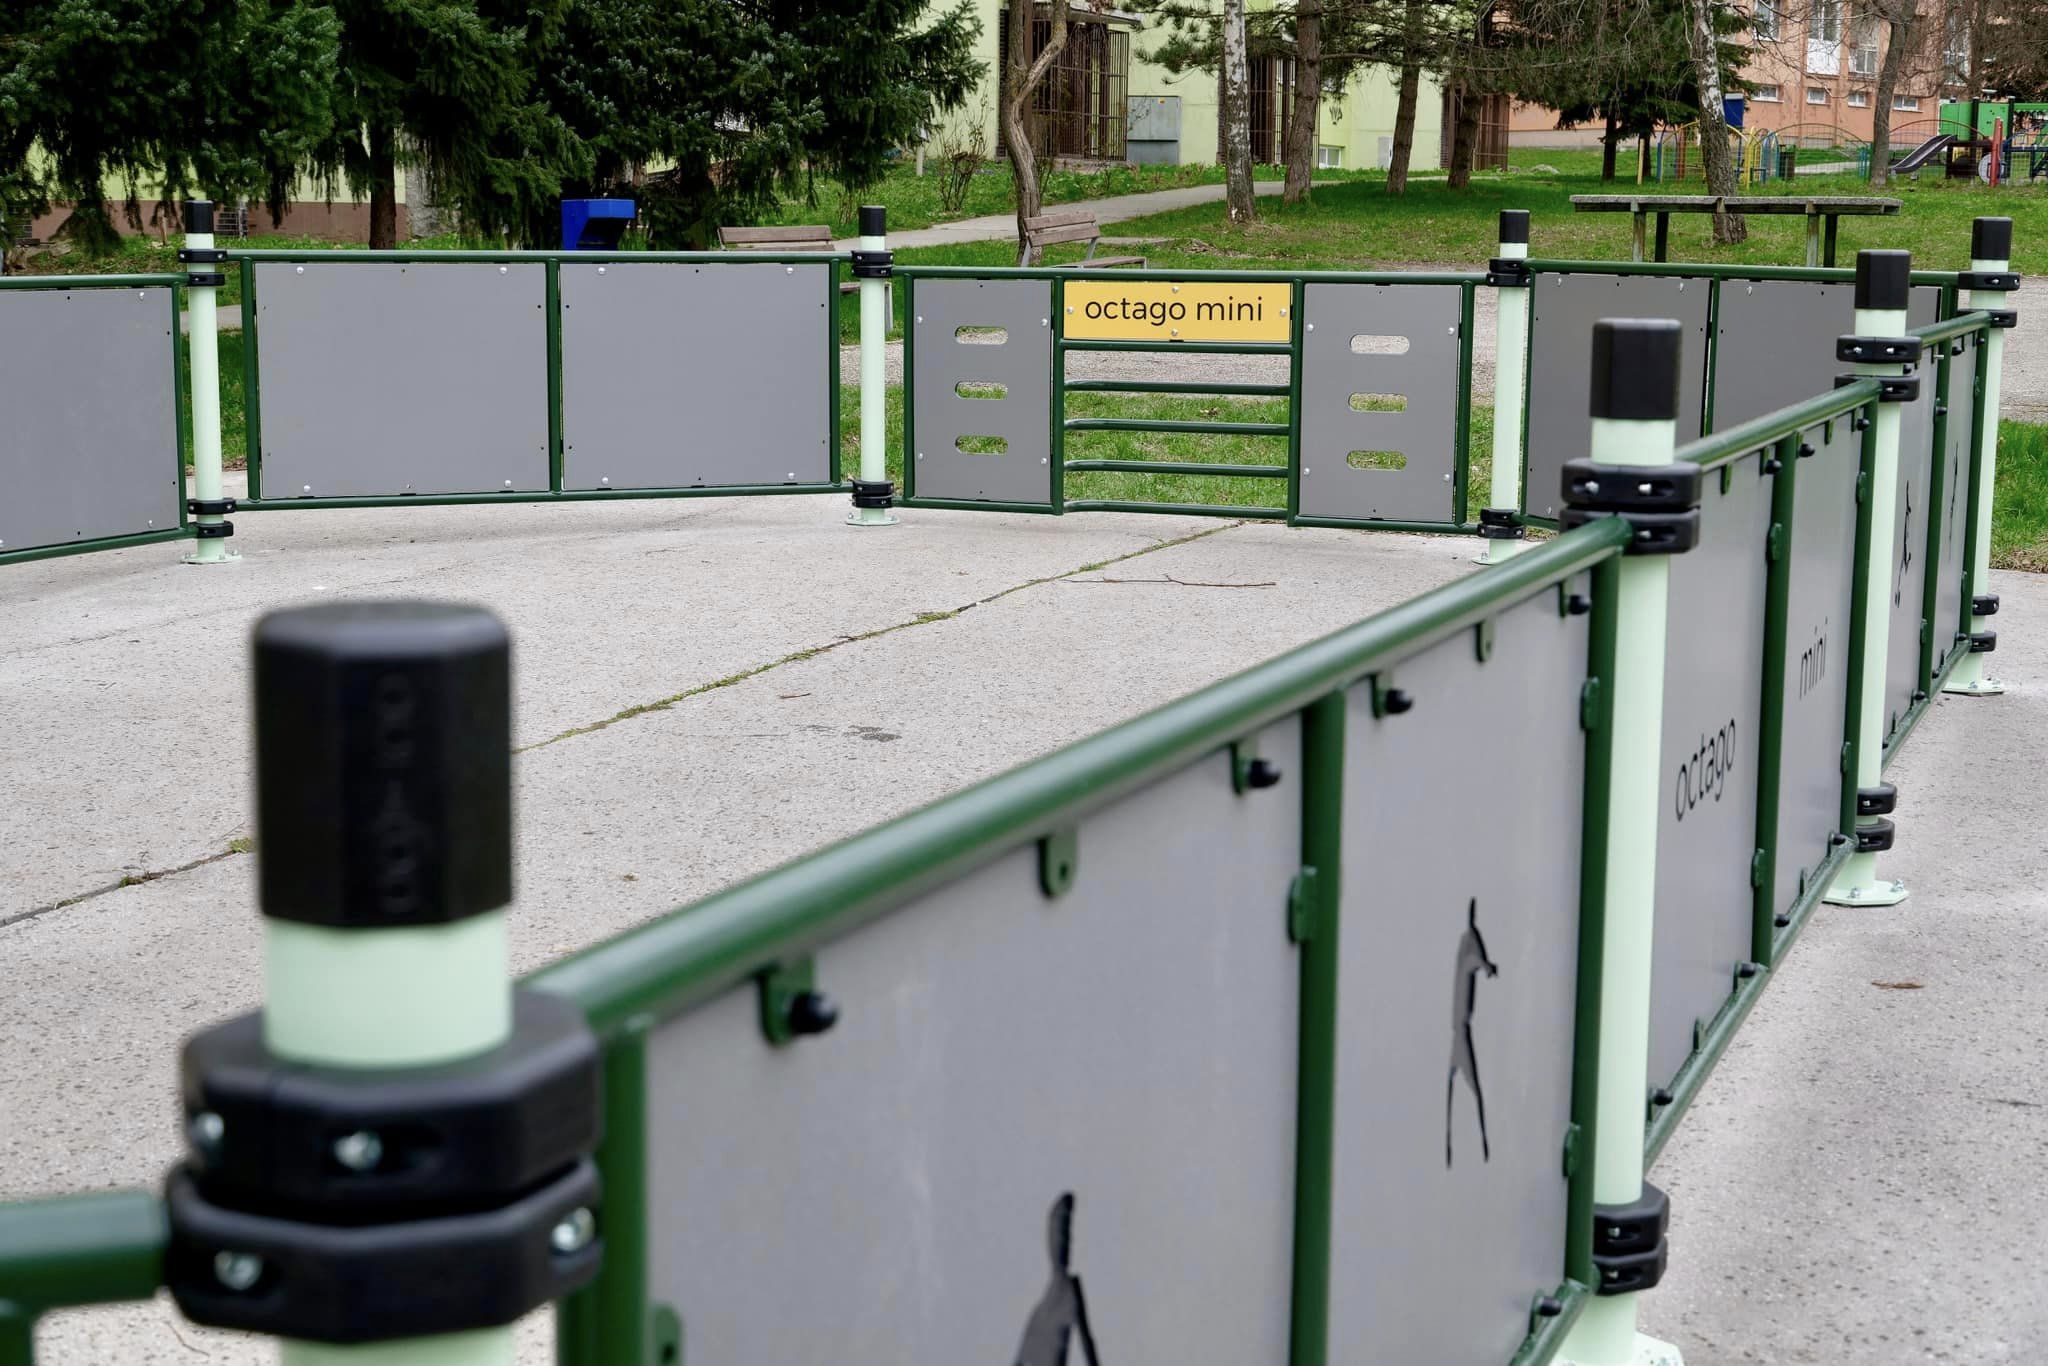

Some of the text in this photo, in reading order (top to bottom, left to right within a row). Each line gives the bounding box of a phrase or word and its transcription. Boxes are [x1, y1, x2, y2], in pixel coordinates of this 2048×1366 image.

[1085, 296, 1263, 327] octago mini
[1675, 615, 1829, 822] octago mini
